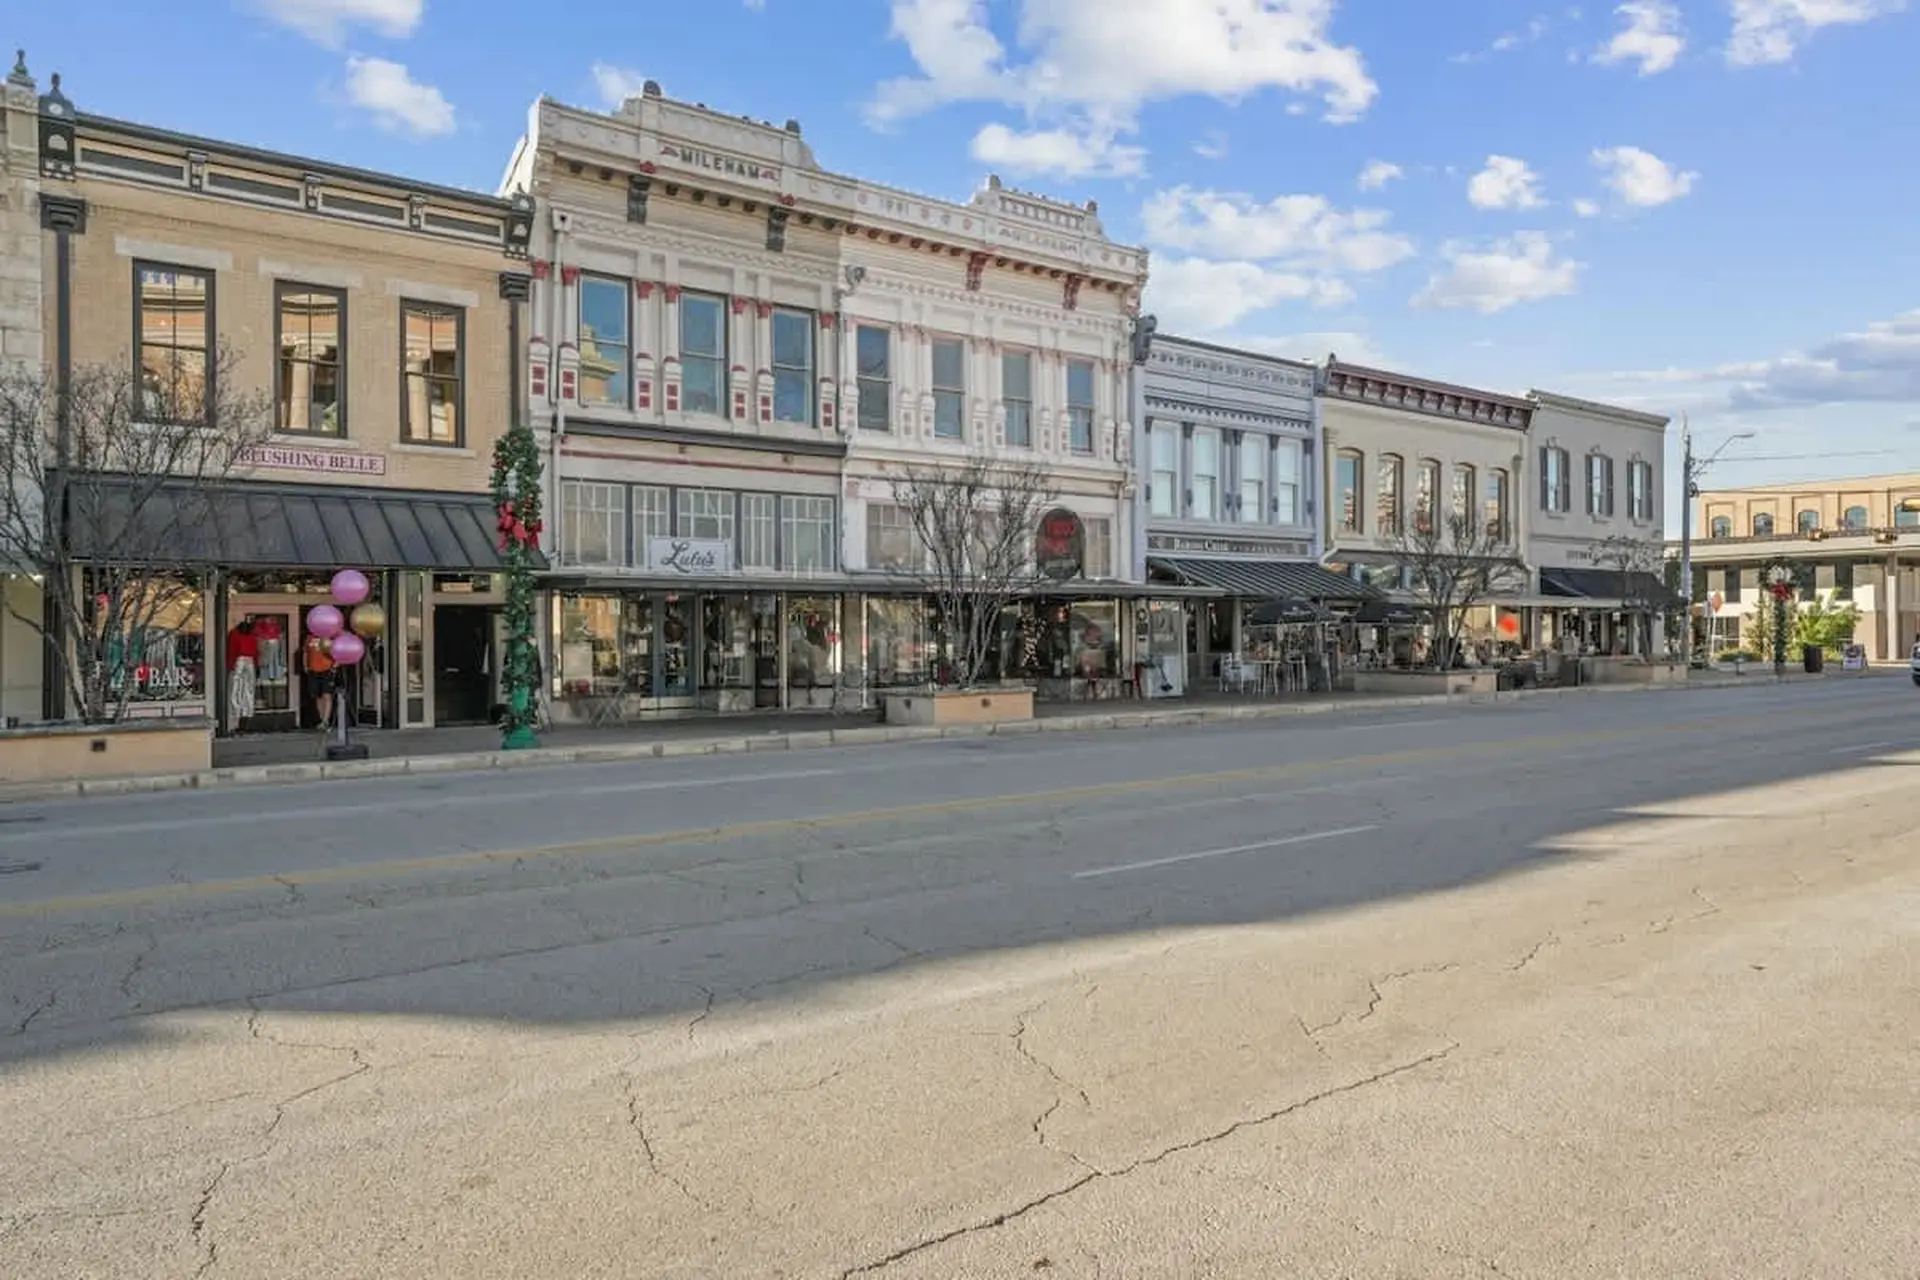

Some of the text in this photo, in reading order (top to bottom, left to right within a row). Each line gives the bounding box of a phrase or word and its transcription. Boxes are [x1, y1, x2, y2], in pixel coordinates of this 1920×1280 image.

[680, 147, 760, 179] MILEHAM
[240, 448, 378, 471] BLUSHING BELLE
